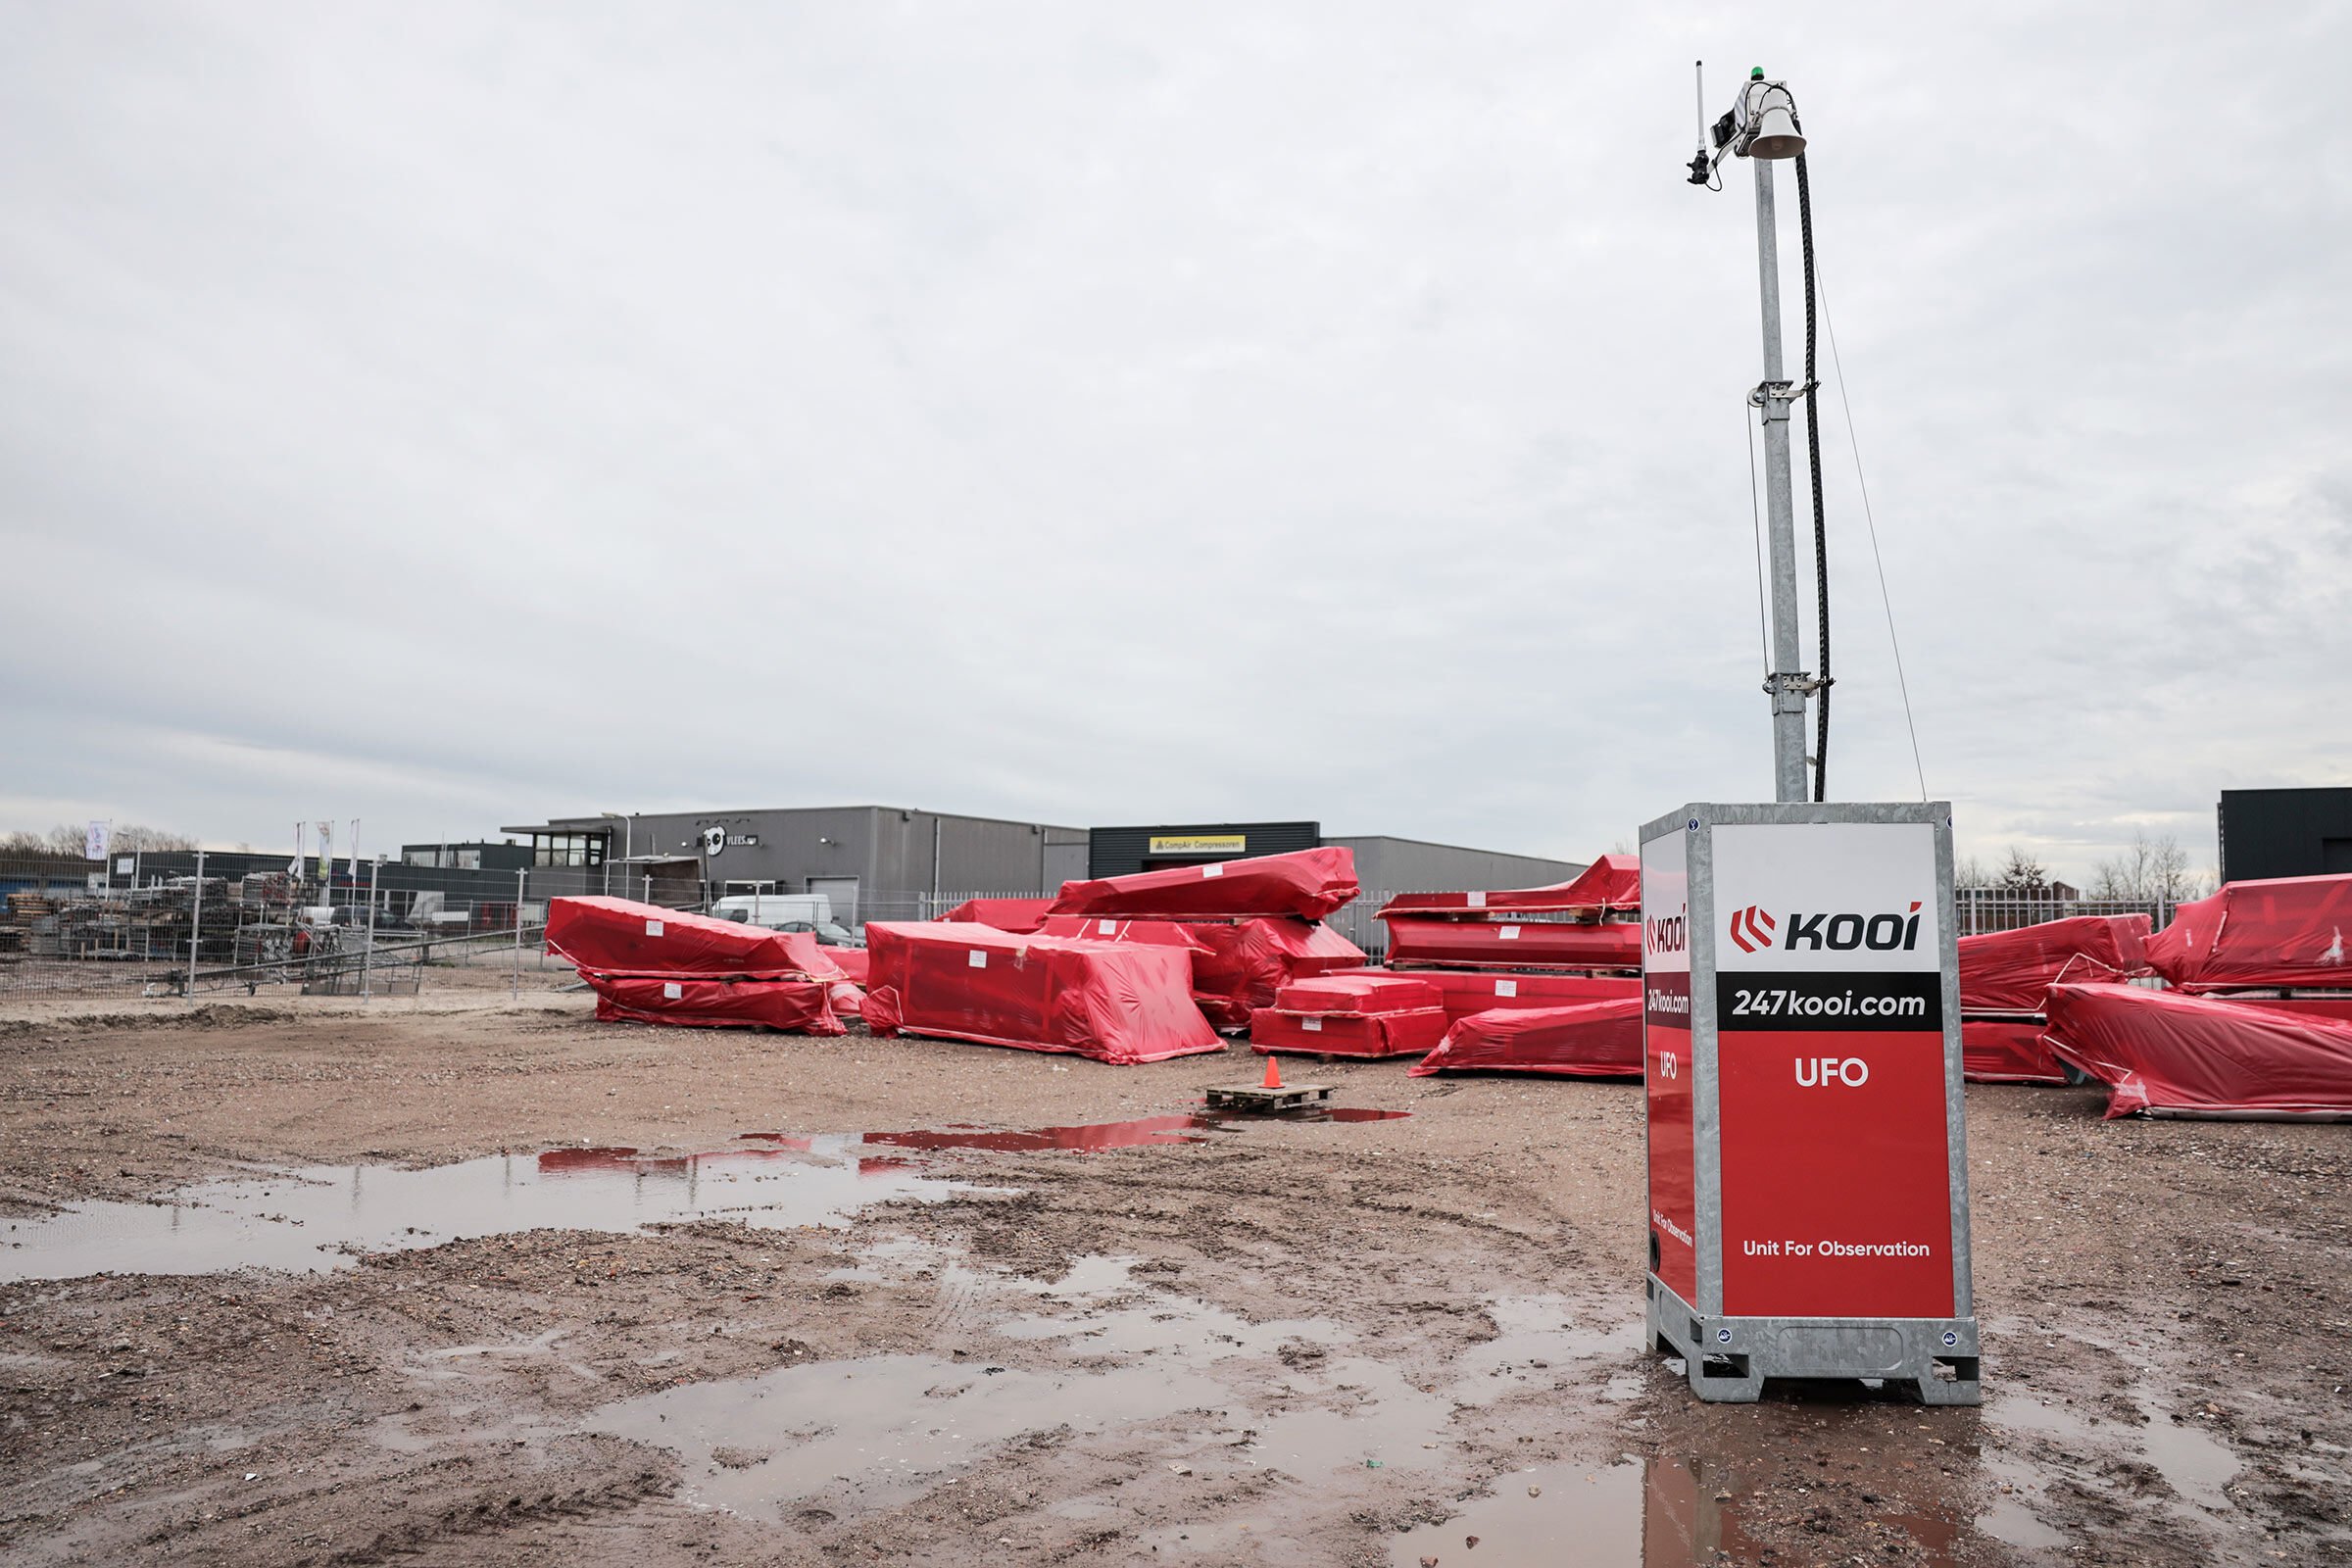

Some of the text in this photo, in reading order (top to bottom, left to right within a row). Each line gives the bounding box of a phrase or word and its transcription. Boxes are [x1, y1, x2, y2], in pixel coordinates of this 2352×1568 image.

[1648, 989, 1689, 1013] 247kooi.com
[1732, 990, 1926, 1016] 247kooi.com
[1660, 1051, 1677, 1079] UFO
[1795, 1057, 1869, 1087] UFO
[1652, 1208, 1661, 1225] Unit
[1667, 1218, 1692, 1248] Observation
[1743, 1240, 1931, 1257] Unit For Observation
